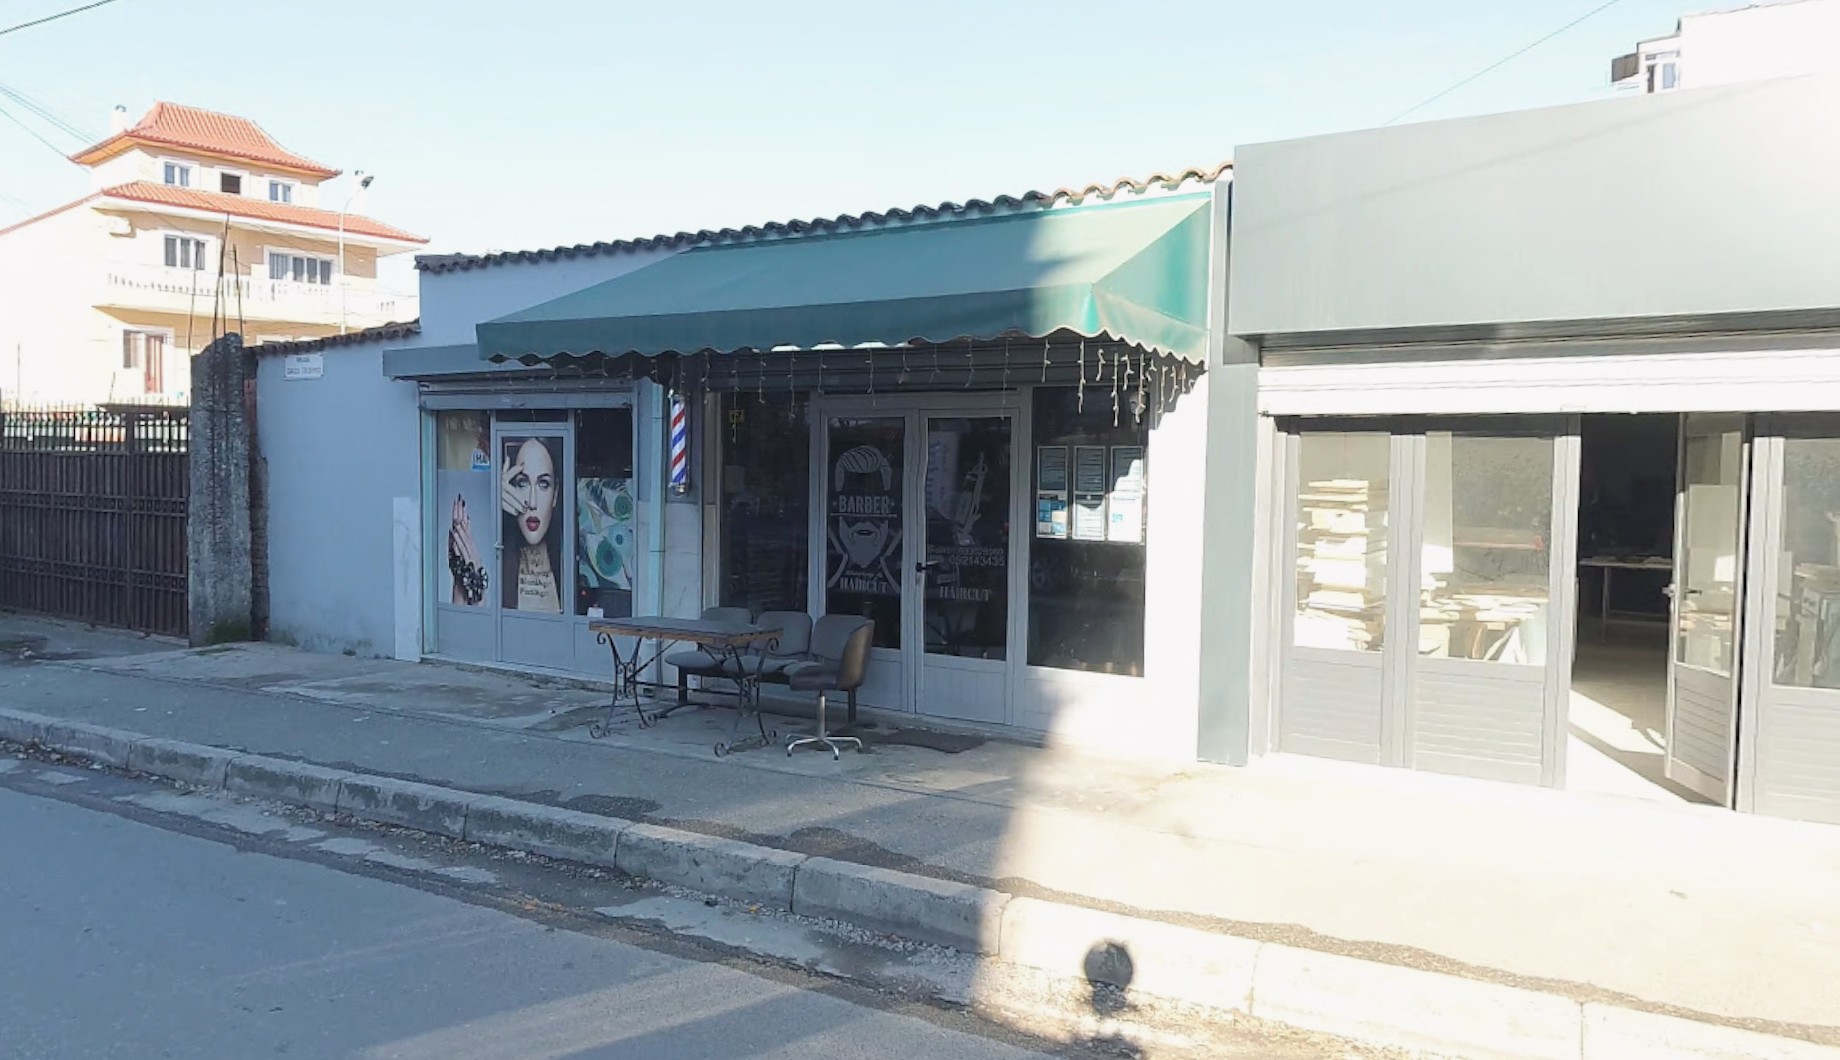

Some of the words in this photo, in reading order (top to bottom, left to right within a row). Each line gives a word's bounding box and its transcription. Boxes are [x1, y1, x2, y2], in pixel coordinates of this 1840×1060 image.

[839, 494, 889, 514] BARBER
[840, 577, 888, 593] HAIRCUT
[939, 586, 992, 601] HAIRCUT
